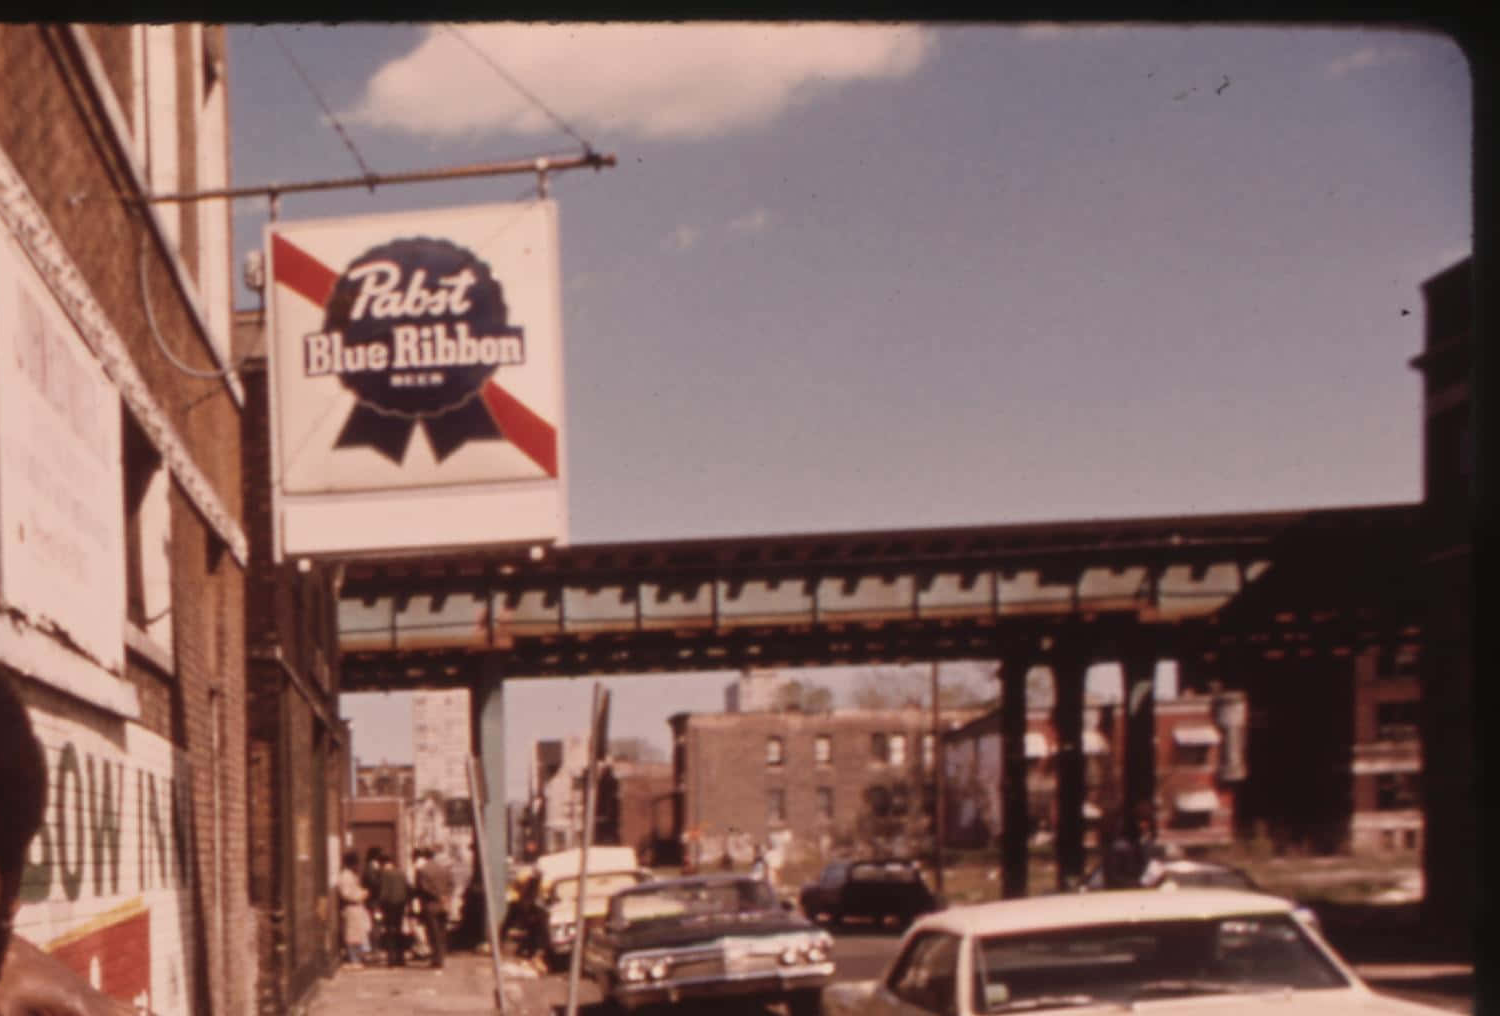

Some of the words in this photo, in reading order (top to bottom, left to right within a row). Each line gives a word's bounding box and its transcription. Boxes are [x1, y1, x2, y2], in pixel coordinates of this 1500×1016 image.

[348, 260, 476, 320] Pabst
[306, 331, 389, 376] Blue
[392, 322, 522, 369] Ribbon
